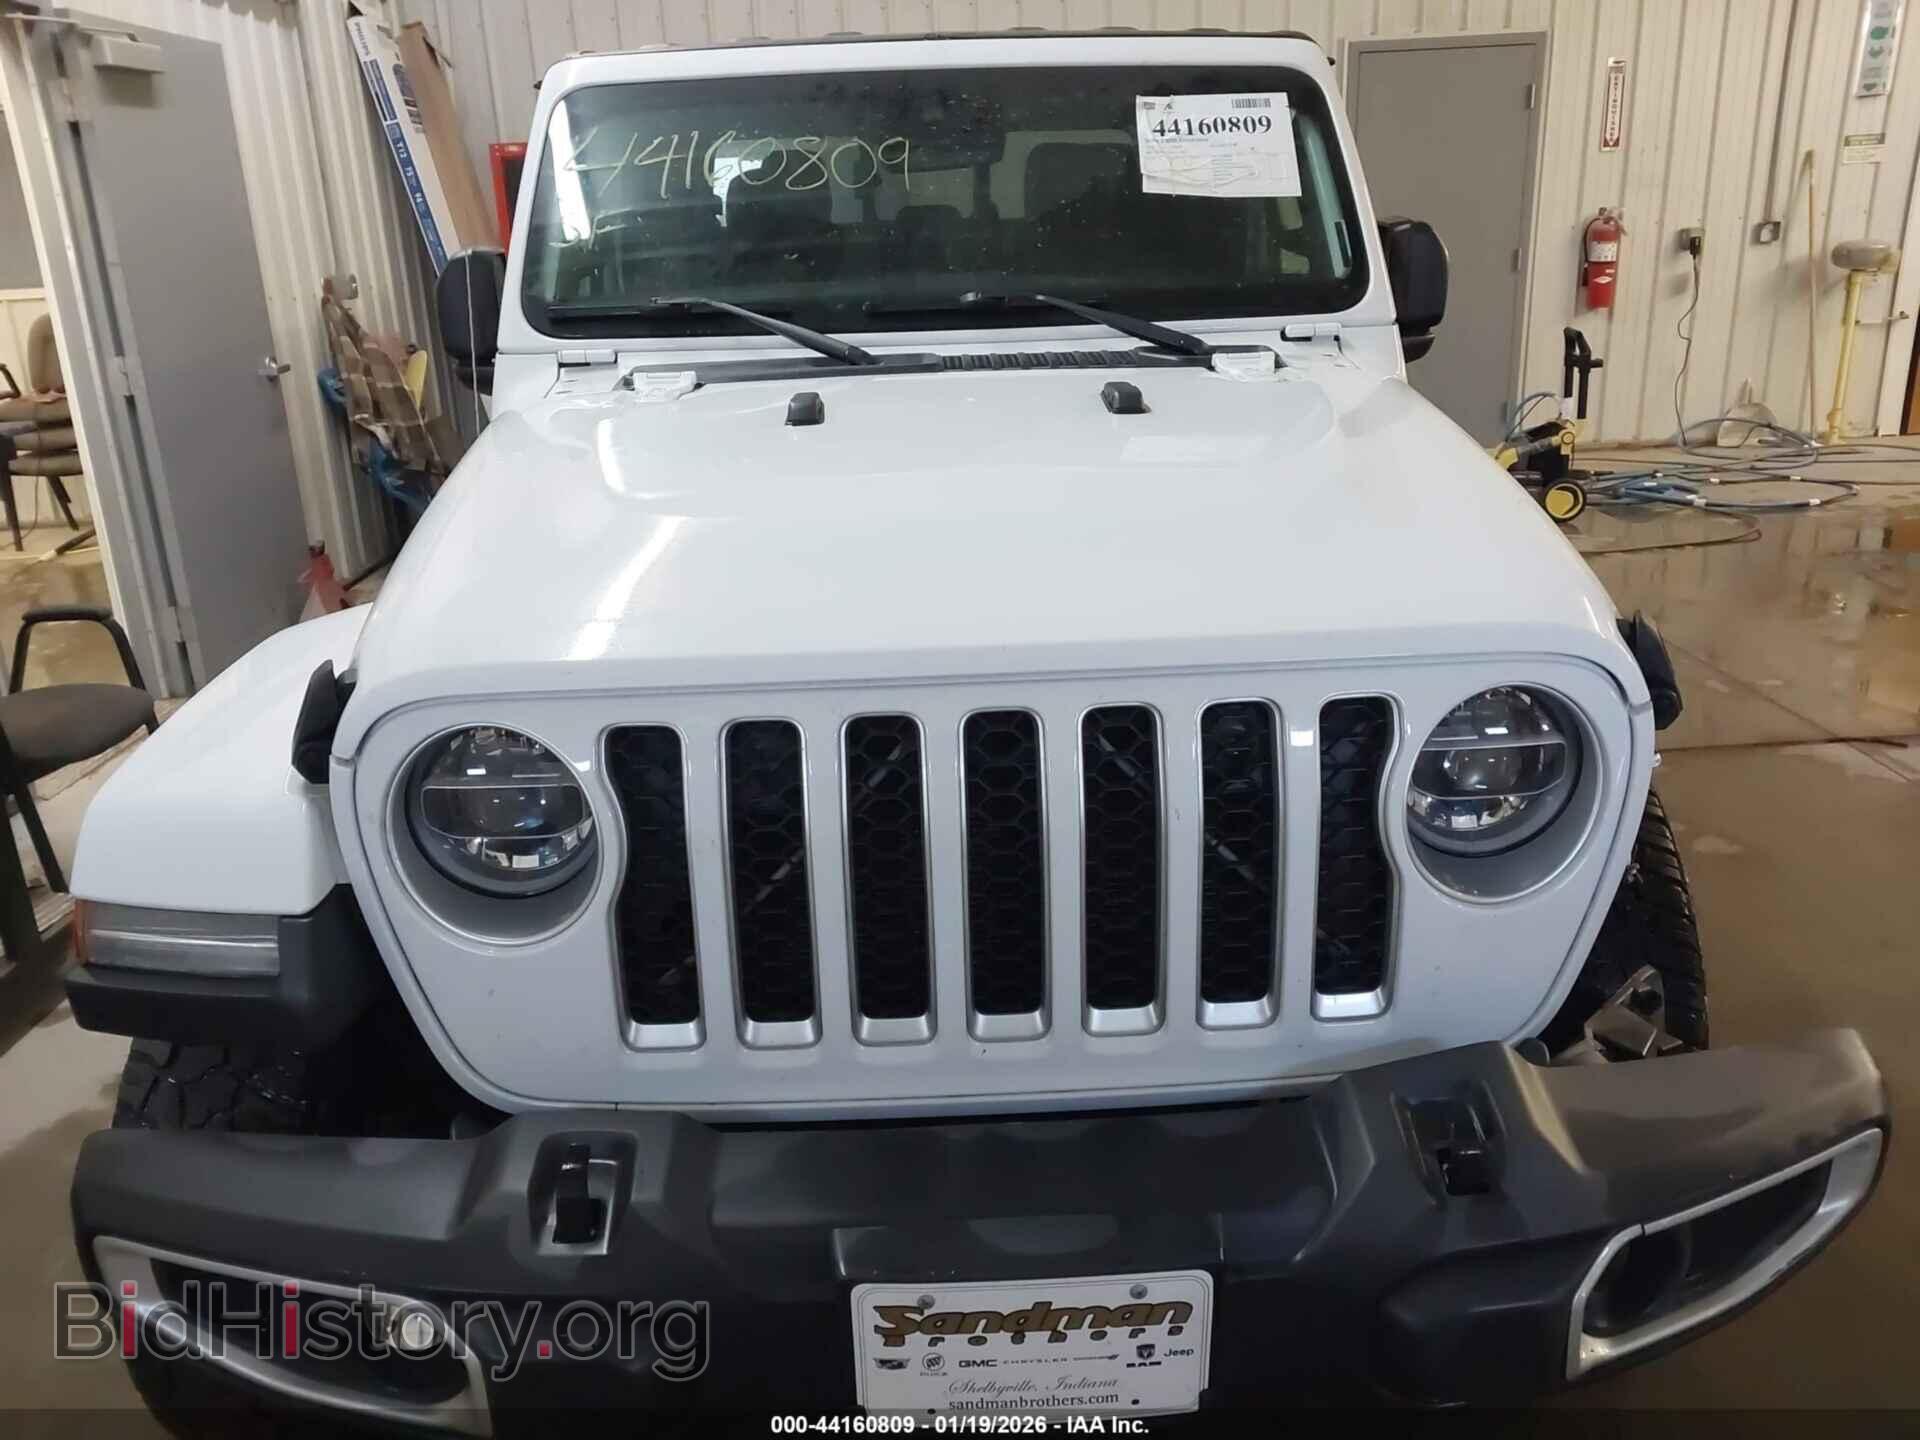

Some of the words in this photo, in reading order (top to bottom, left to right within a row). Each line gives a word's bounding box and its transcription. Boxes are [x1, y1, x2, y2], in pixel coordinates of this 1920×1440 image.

[1151, 115, 1272, 137] 44160809
[563, 126, 911, 199] 44160809
[873, 1301, 1194, 1336] Sandman
[1164, 1348, 1195, 1358] Jeep
[958, 1358, 998, 1369] GMC
[1049, 1373, 1120, 1391] Indiana
[949, 1393, 1120, 1411] sandmanbrothers.com
